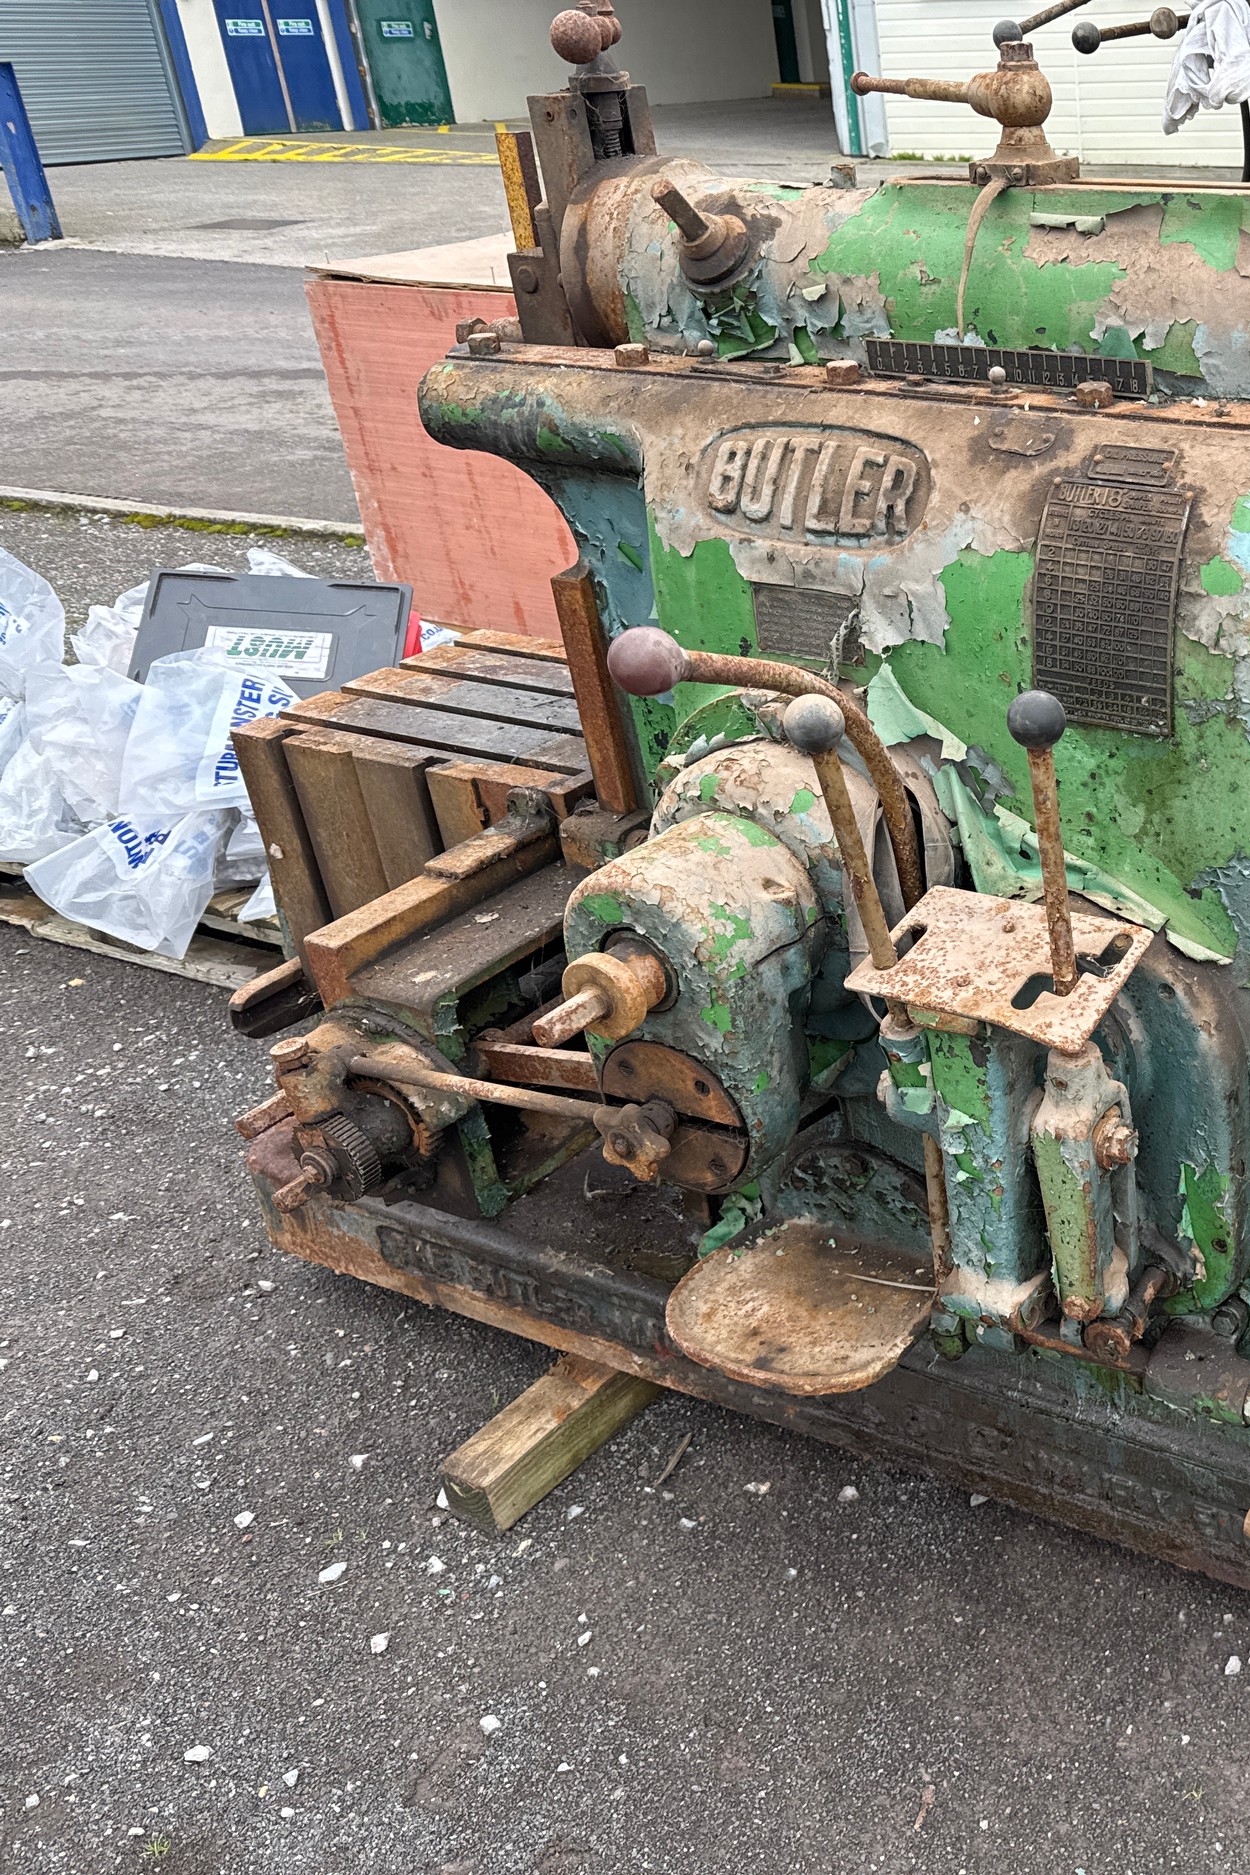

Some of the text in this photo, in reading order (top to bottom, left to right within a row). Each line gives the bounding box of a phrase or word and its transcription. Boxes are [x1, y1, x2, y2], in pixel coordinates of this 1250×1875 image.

[1121, 450, 1168, 462] PRESSURE
[708, 437, 918, 537] BUTLER
[1058, 483, 1100, 505] BUTLER
[1088, 509, 1122, 520] CYCLES
[226, 635, 314, 660] MUST
[1087, 678, 1116, 690] FEEDS
